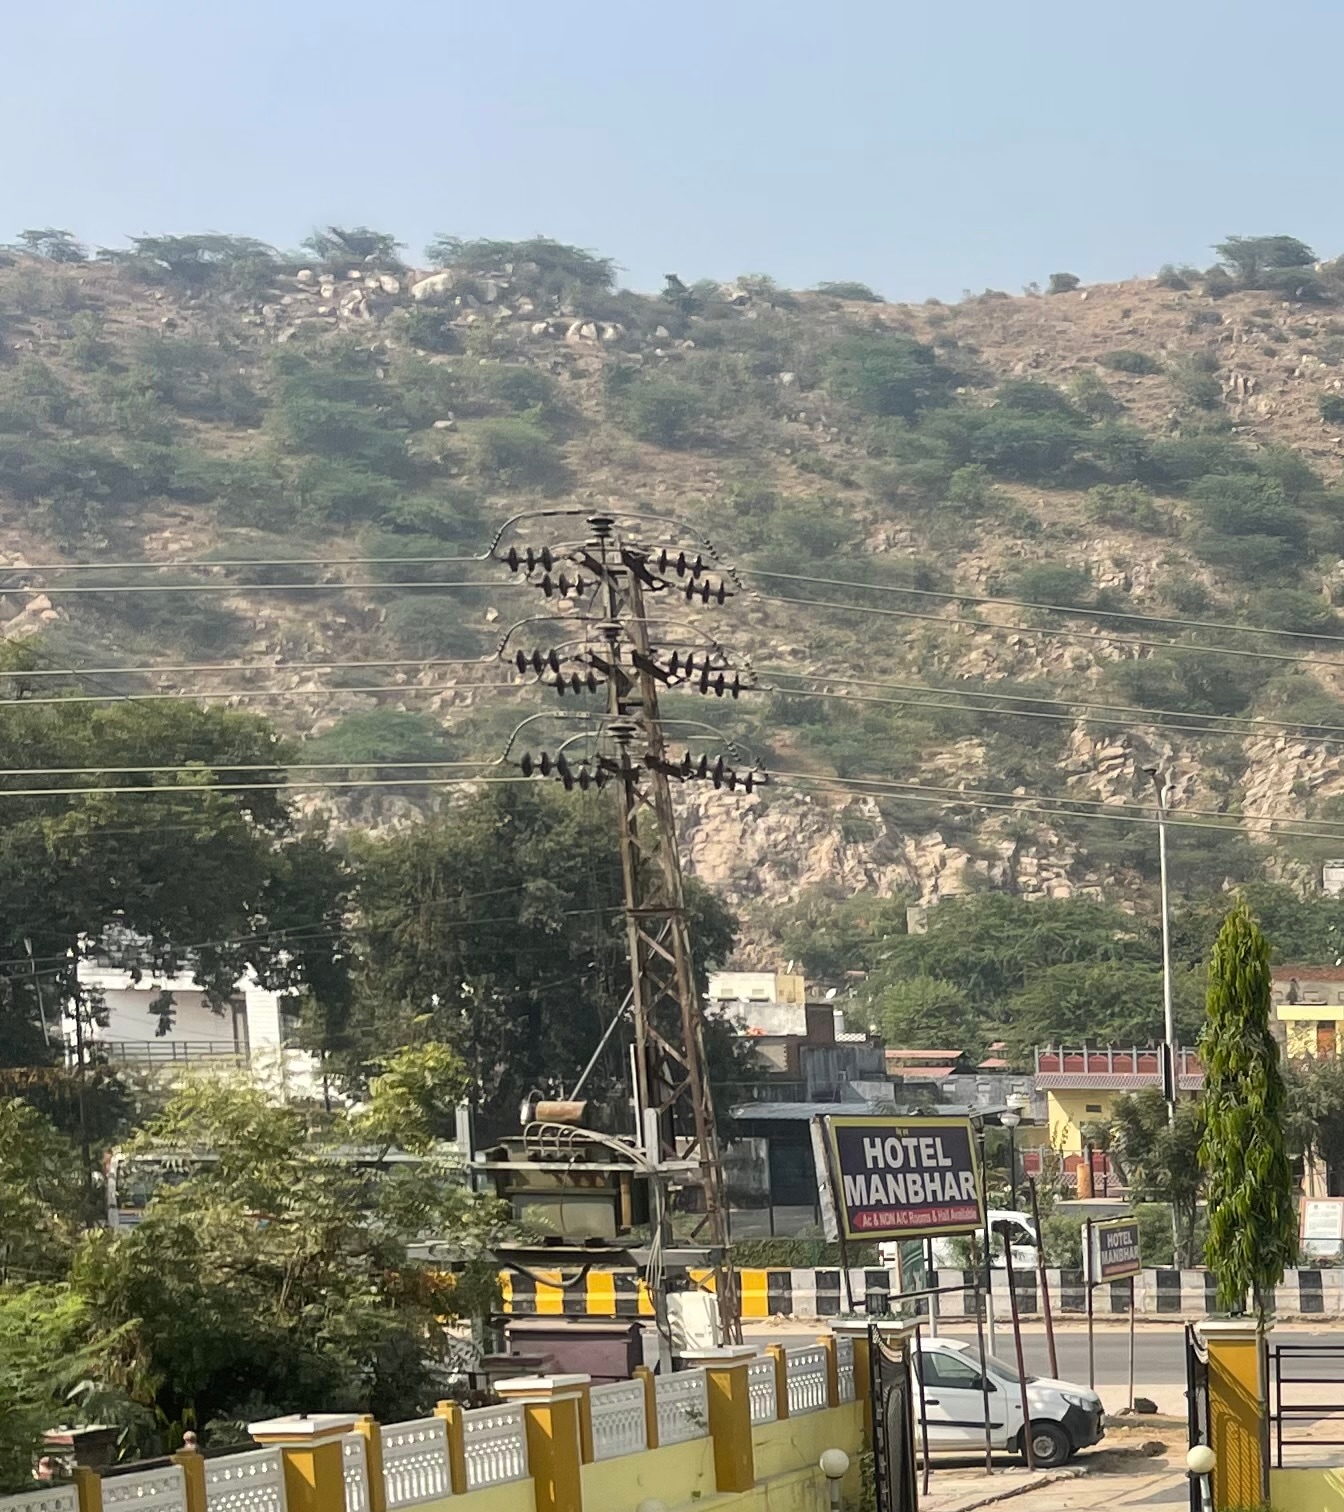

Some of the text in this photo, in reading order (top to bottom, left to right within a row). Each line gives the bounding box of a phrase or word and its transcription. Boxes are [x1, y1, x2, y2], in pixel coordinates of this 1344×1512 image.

[863, 1136, 952, 1169] HOTEL
[843, 1171, 978, 1207] MANBHAR
[880, 1212, 896, 1226] NON
[909, 1211, 931, 1224] Rooms
[1106, 1231, 1133, 1248] HOTEL
